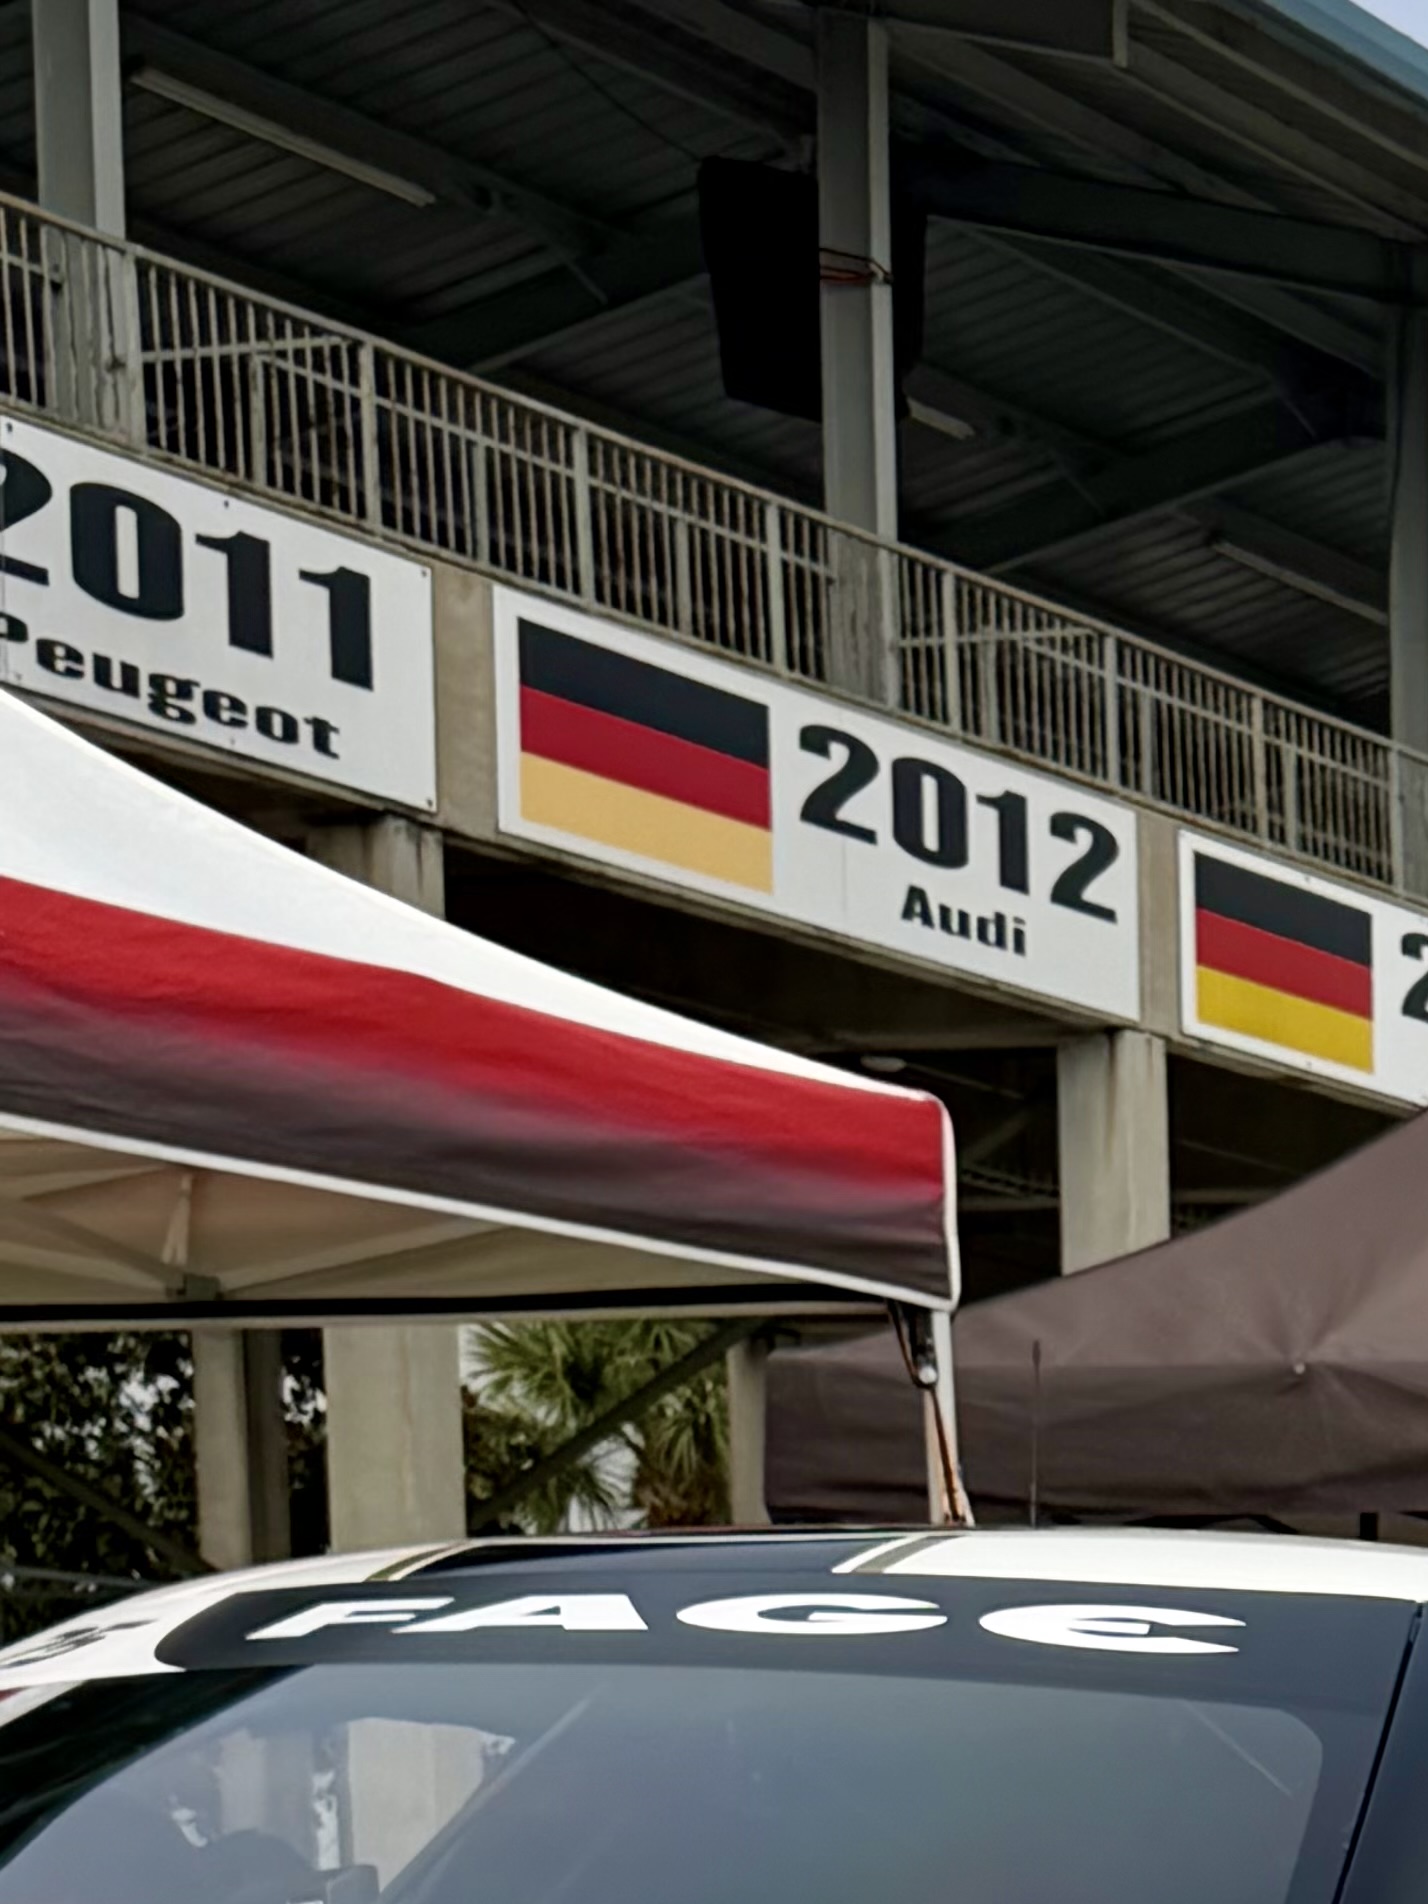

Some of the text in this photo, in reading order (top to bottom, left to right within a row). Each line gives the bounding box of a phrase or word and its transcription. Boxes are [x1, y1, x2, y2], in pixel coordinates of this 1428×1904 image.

[799, 724, 1120, 925] 2012
[901, 884, 1026, 957] Audi
[246, 1594, 1247, 1653] FAGE
